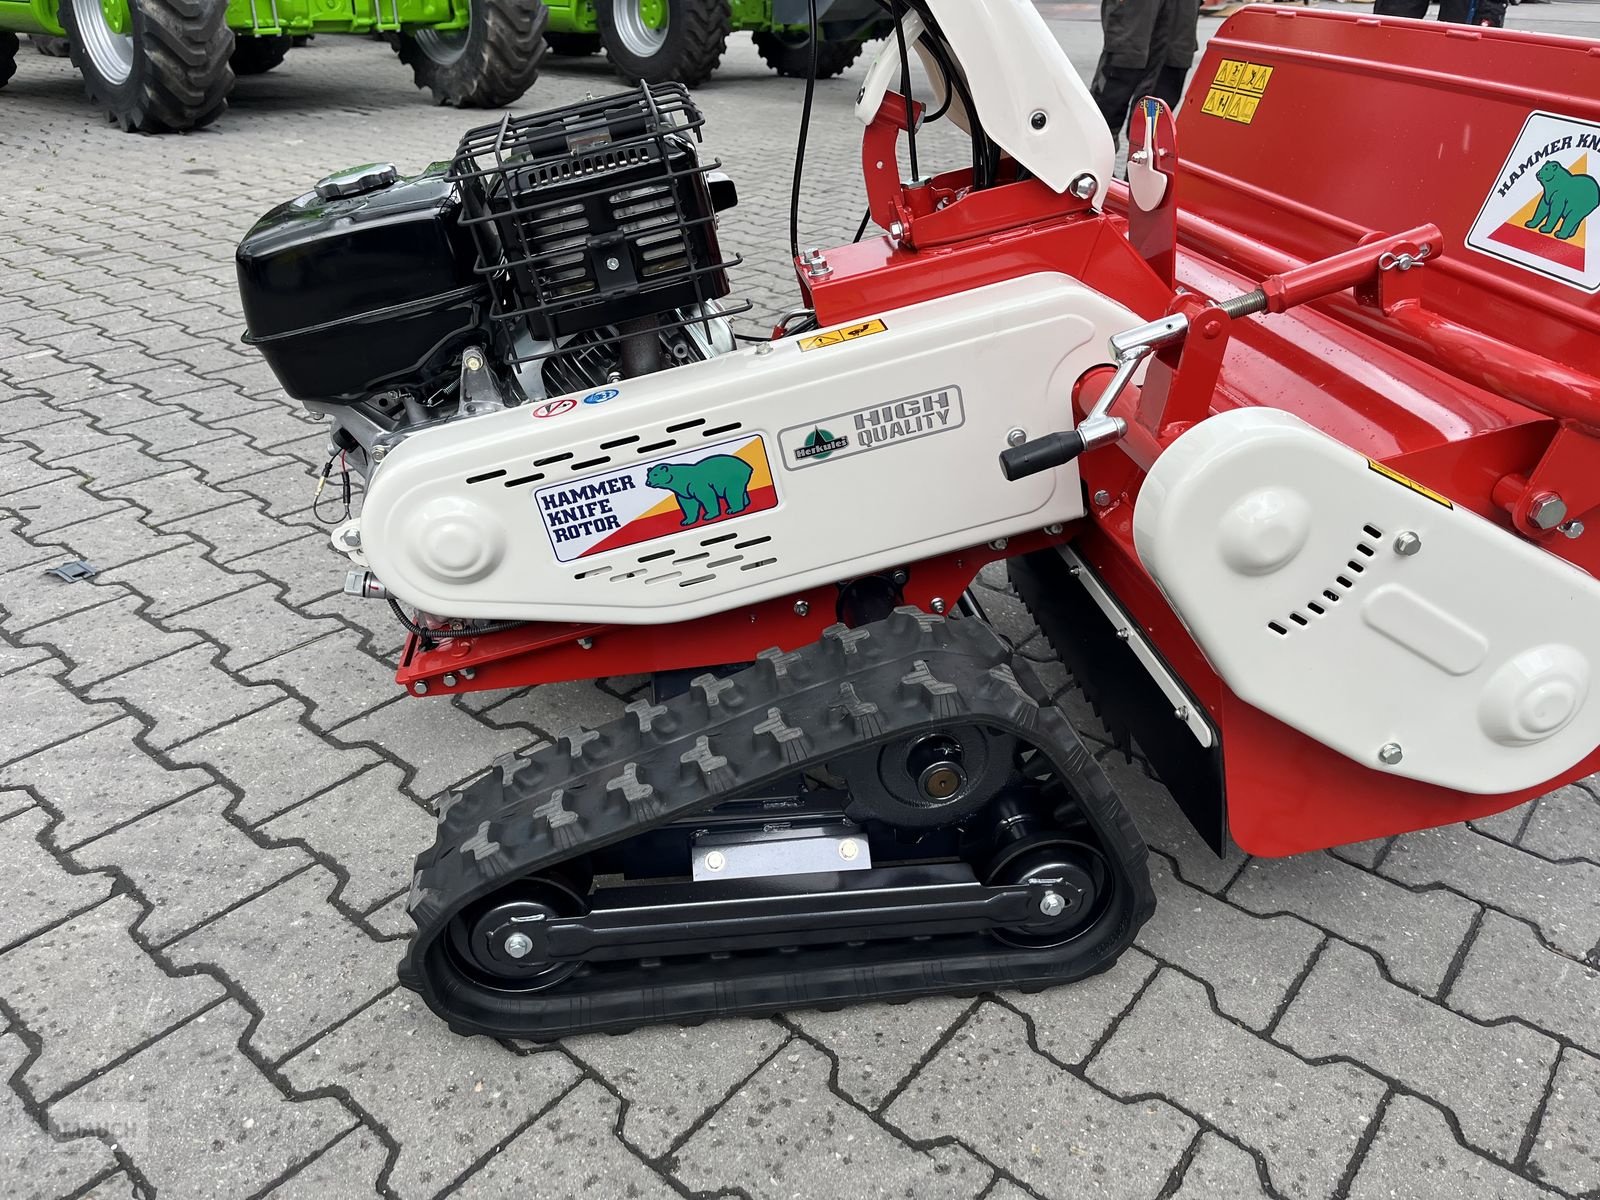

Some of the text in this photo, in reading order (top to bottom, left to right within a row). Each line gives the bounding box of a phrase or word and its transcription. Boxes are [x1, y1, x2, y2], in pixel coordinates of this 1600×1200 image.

[1497, 133, 1600, 197] HAMMER KN
[853, 391, 949, 430] HIGH
[857, 409, 950, 447] QUALITY
[796, 437, 848, 459] Herkules
[541, 475, 636, 510] HAMMER
[547, 498, 613, 527] KNIFE
[553, 514, 621, 543] ROTOR
